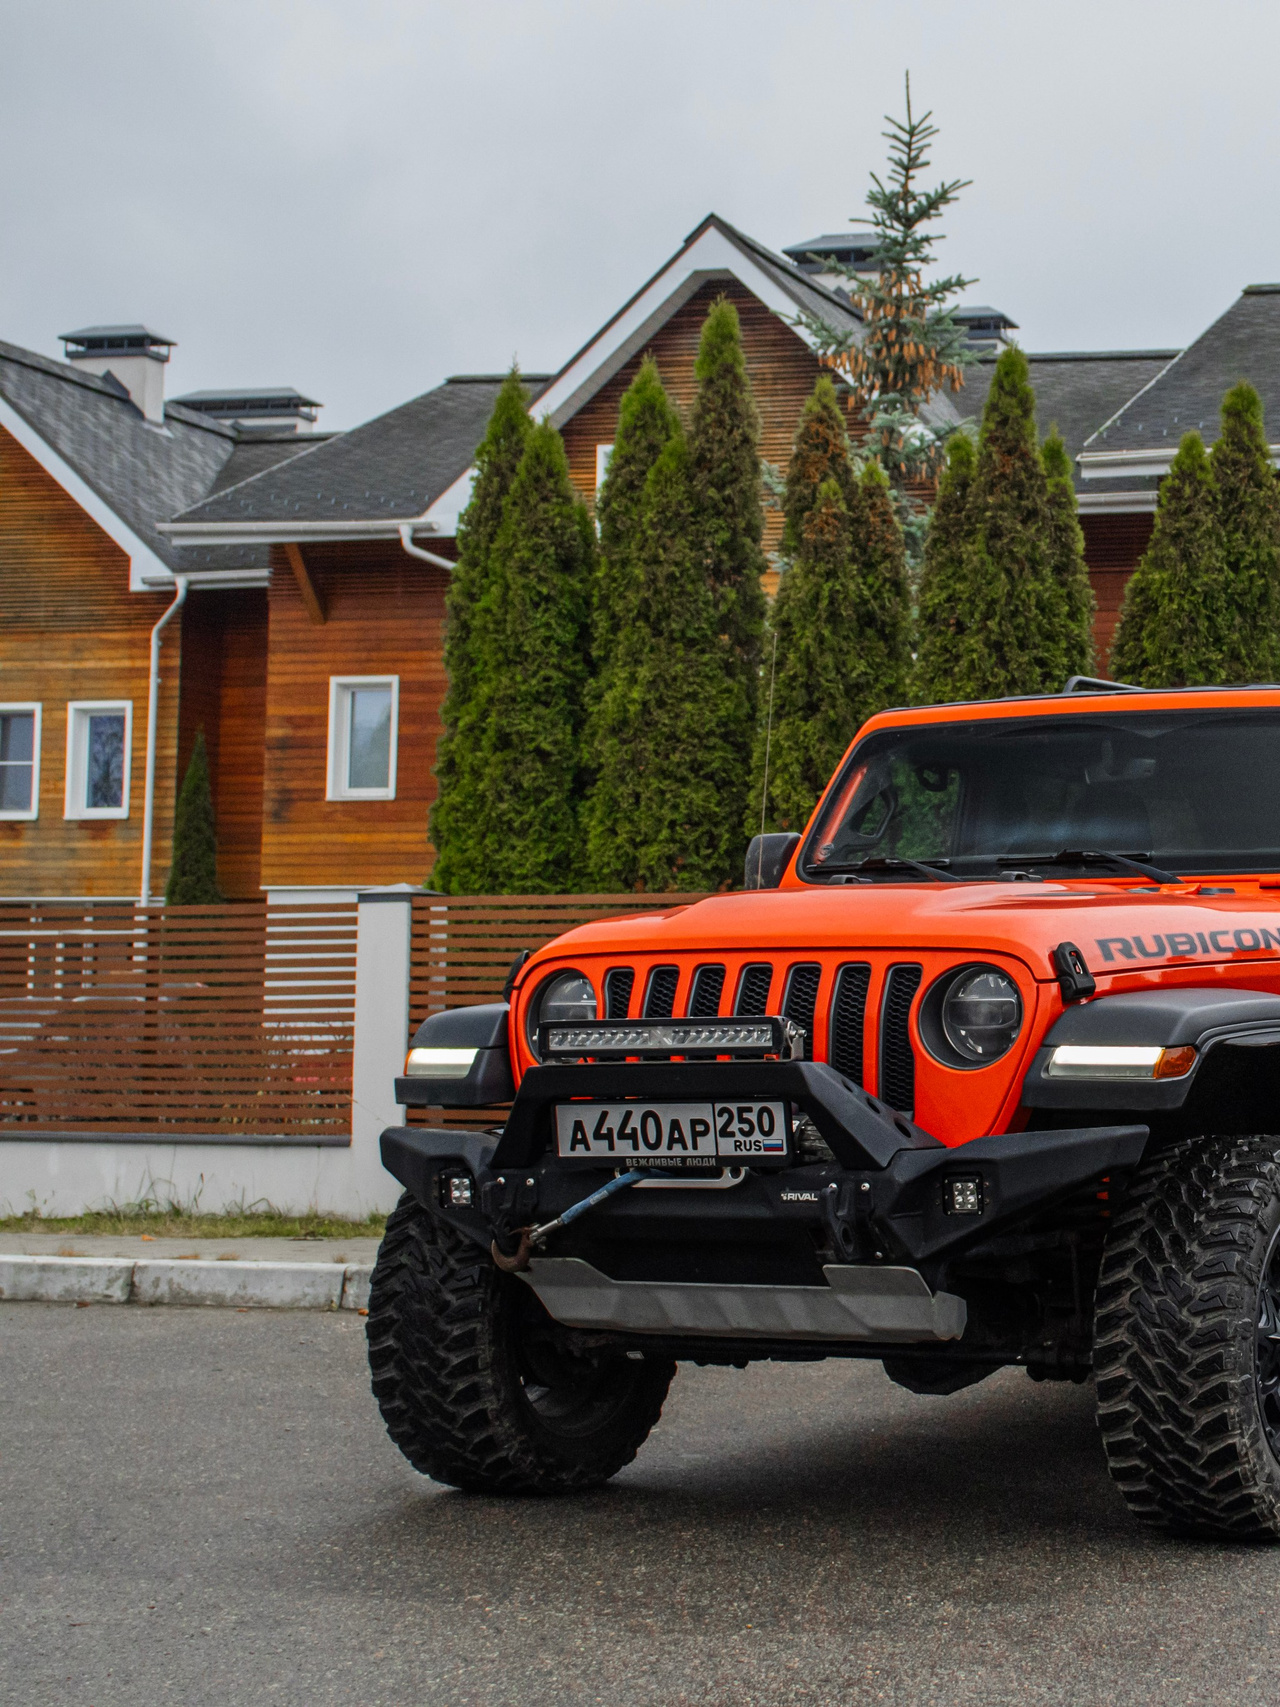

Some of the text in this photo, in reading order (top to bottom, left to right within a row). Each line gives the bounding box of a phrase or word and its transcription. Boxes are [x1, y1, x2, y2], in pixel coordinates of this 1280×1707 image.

[717, 1106, 774, 1137] 250
[734, 1139, 762, 1152] RUS
[626, 1157, 716, 1167] ВЕЖЛИВЫЕ ЛЮДИ
[787, 1192, 818, 1201] RIVAL
